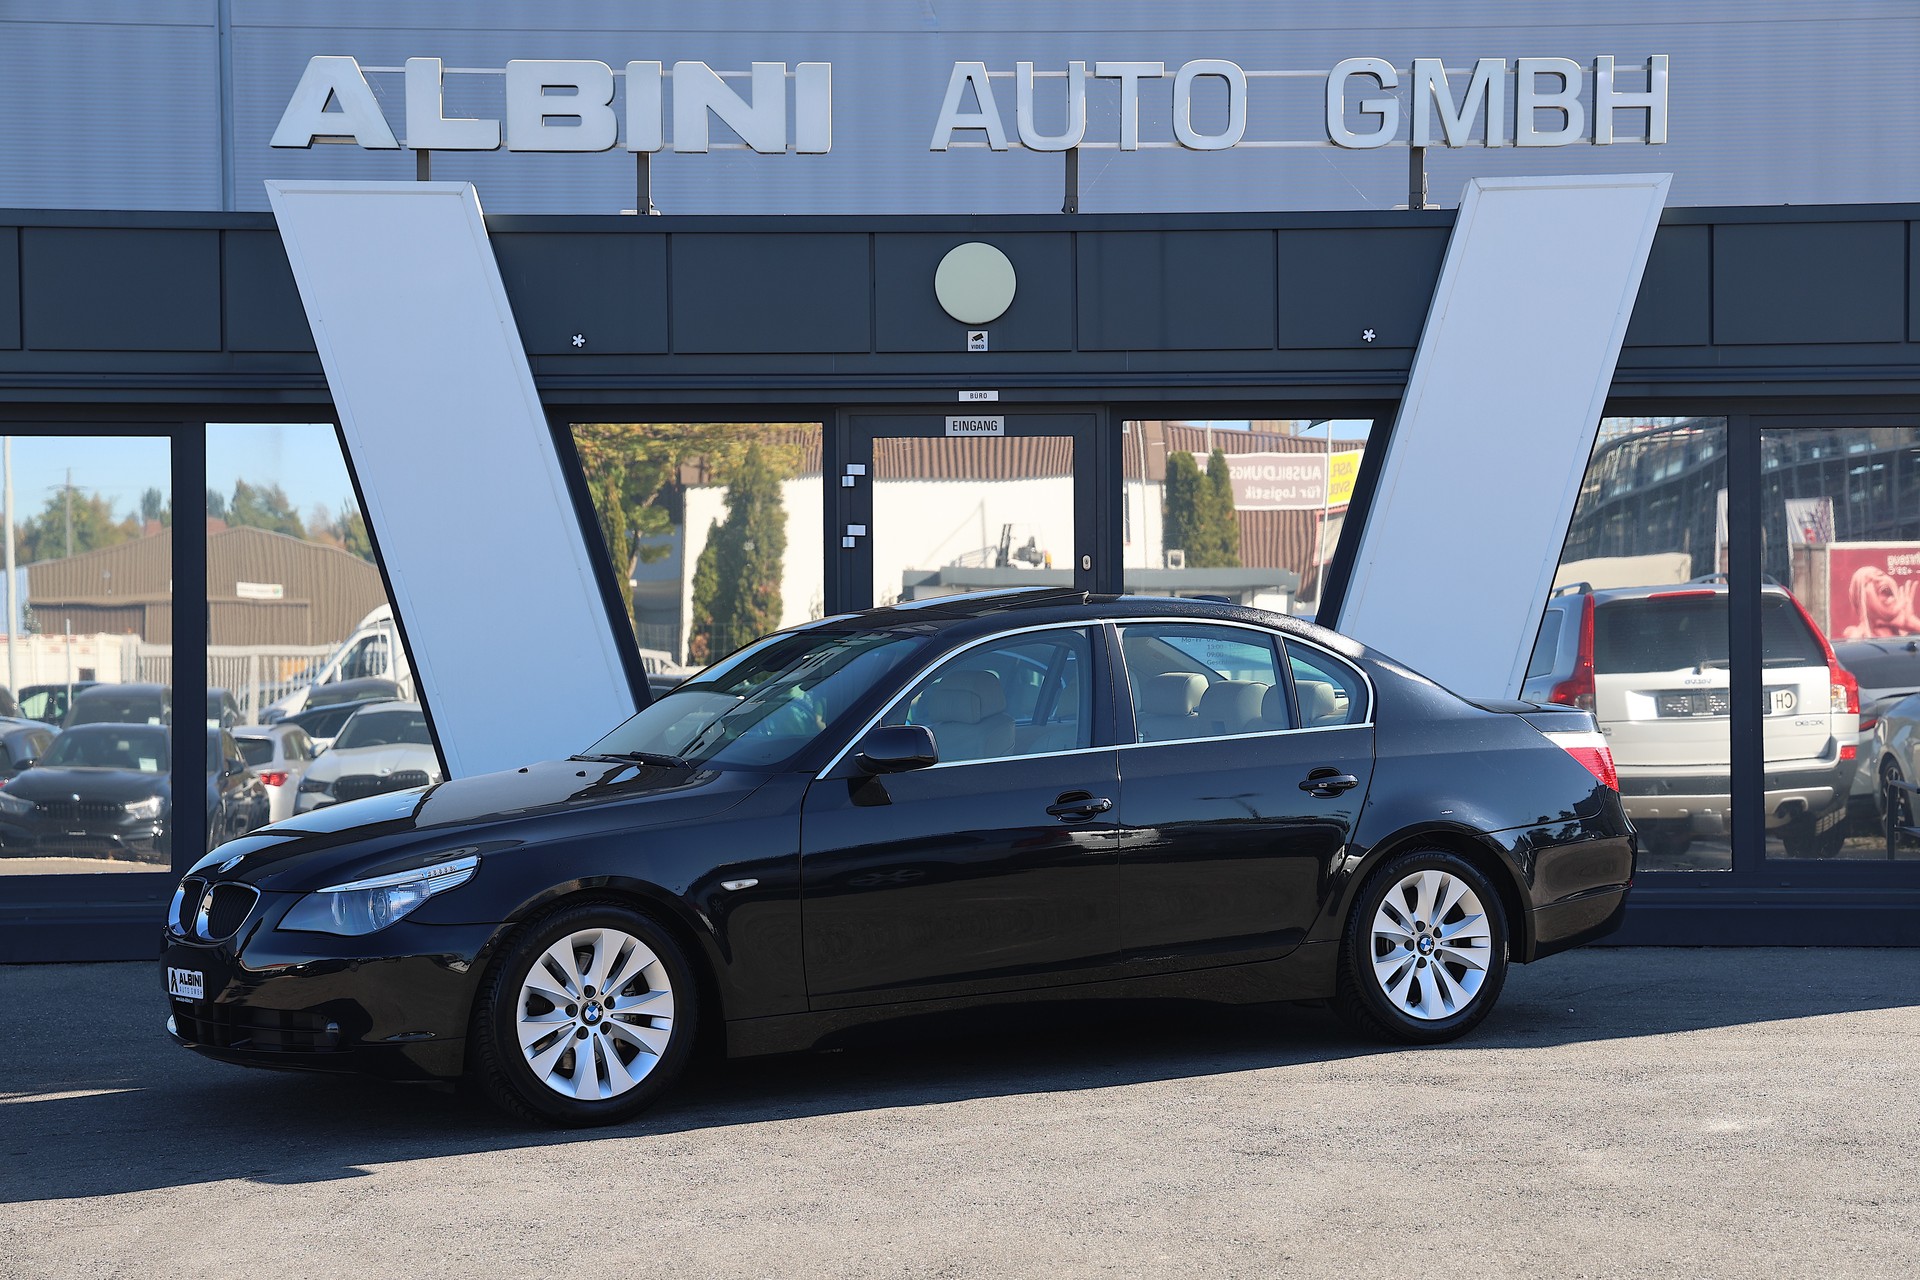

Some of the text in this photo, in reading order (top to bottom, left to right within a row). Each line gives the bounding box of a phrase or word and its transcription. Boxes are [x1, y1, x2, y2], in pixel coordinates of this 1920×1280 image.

[269, 54, 1669, 154] ALBINI AUTO GMBH
[952, 420, 998, 432] EINGANG
[180, 973, 201, 987] ALBINI
